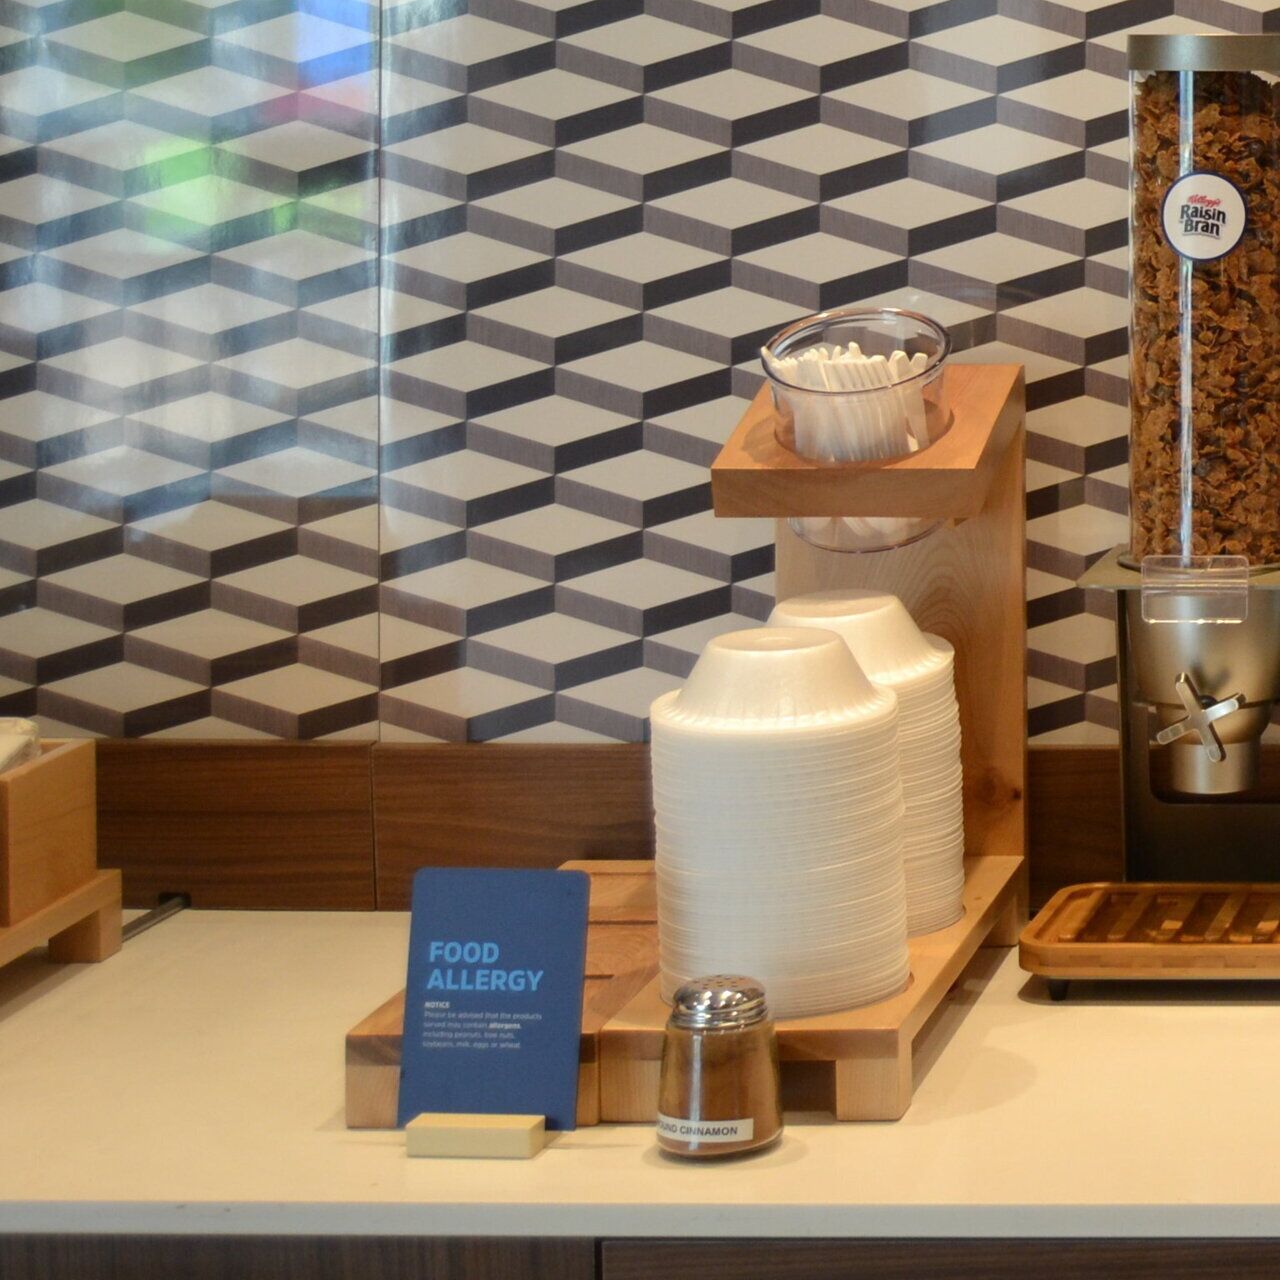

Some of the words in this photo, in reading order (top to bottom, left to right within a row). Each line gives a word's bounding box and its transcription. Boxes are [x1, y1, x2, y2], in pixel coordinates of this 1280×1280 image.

[1180, 205, 1226, 224] Raisin
[1184, 219, 1220, 236] Bran
[429, 941, 500, 964] FOOD
[426, 969, 544, 992] ALLERGY
[424, 1001, 451, 1009] NOTICE
[680, 1125, 739, 1136] CINNAMON
